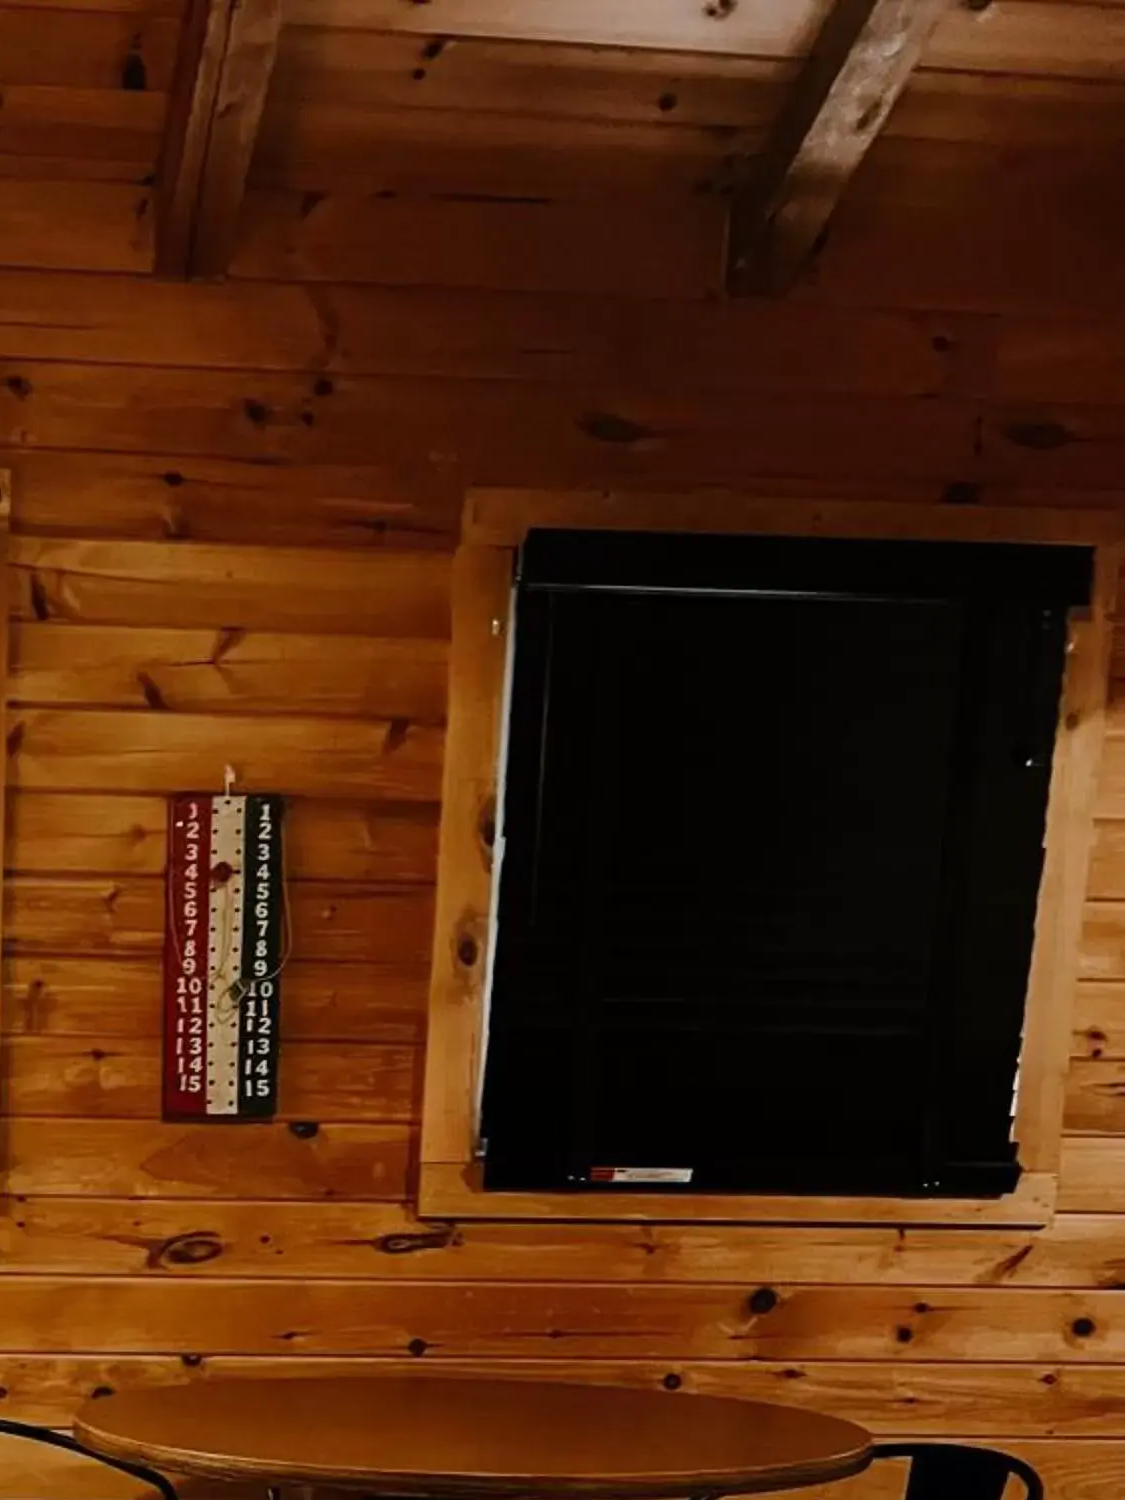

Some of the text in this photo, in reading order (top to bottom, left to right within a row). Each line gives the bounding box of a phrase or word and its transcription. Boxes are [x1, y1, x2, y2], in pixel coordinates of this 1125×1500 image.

[188, 802, 198, 820] 1
[259, 803, 271, 820] 1
[186, 821, 200, 839] 2
[258, 823, 272, 840] 2
[184, 844, 198, 861] 3
[257, 844, 270, 861] 3
[184, 864, 199, 879] 4
[256, 864, 271, 880] 4
[184, 882, 197, 899] 5
[256, 882, 270, 900] 5
[183, 901, 198, 917] 6
[255, 902, 270, 918] 6
[184, 920, 198, 936] 7
[256, 920, 270, 937] 7
[184, 940, 197, 957] 8
[255, 940, 268, 957] 8
[182, 958, 197, 975] 9
[253, 960, 268, 977] 9
[176, 977, 203, 995] 10
[247, 982, 274, 998] 10
[176, 996, 203, 1013] 11
[245, 1000, 268, 1017] 11
[176, 1018, 203, 1035] 12
[246, 1018, 272, 1035] 12
[176, 1037, 203, 1055] 13
[247, 1038, 271, 1055] 13
[177, 1057, 203, 1074] 14
[244, 1059, 269, 1076] 14
[179, 1075, 202, 1092] 15
[244, 1080, 270, 1097] 15
